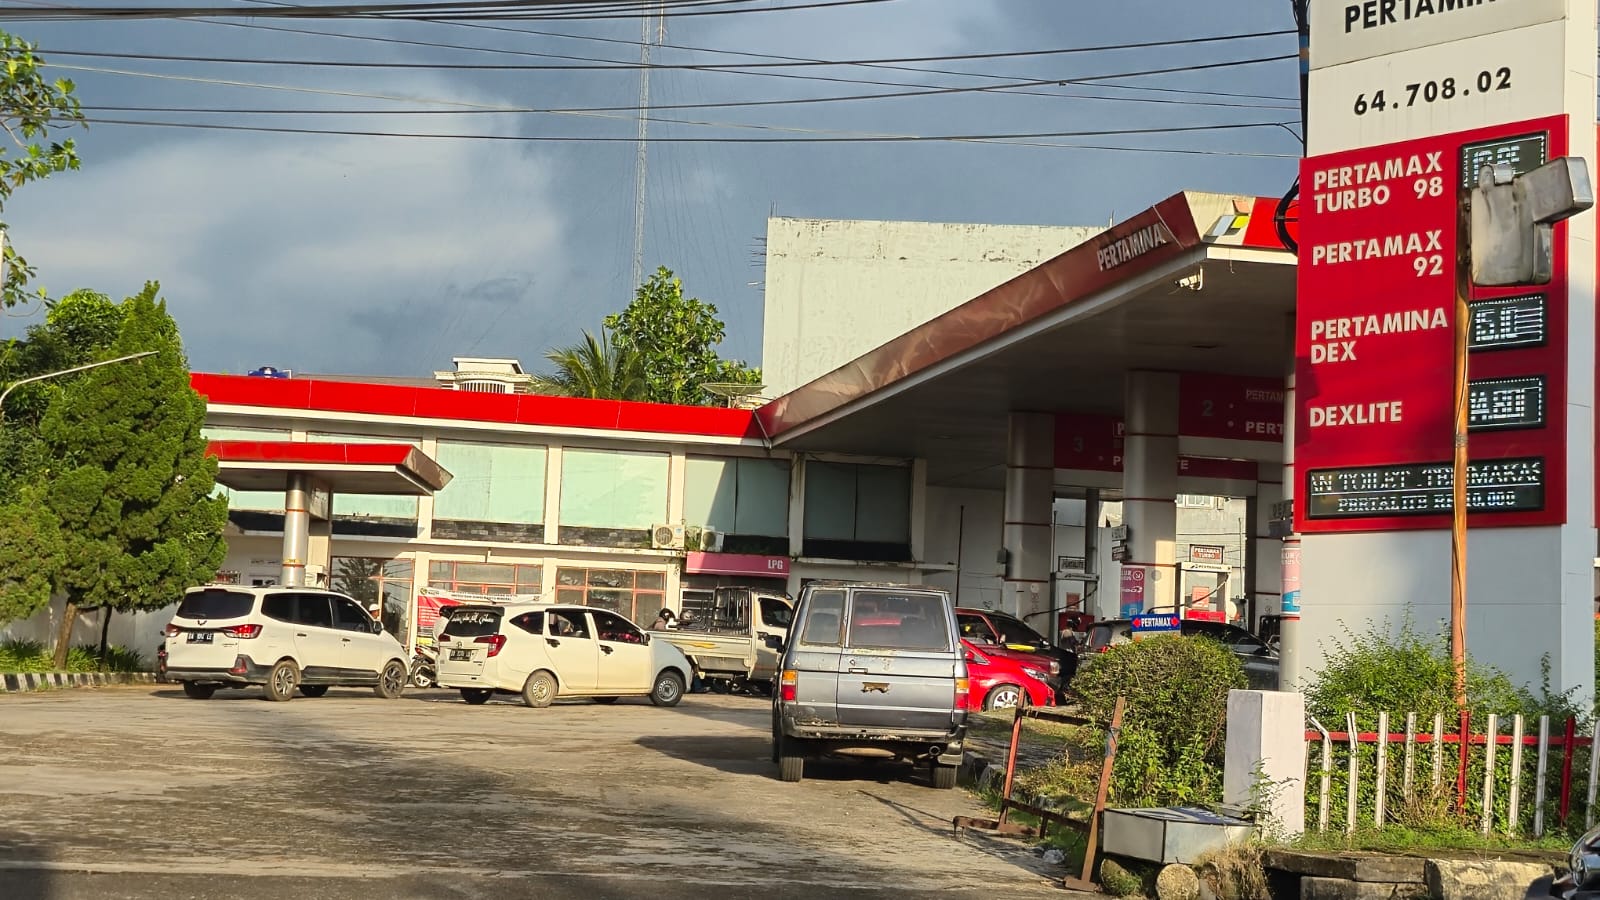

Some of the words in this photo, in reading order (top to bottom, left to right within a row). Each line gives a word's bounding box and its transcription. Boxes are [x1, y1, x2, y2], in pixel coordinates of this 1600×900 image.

[1345, 0, 1497, 33] PERTA
[1353, 66, 1512, 116] 64.708.02
[1313, 151, 1443, 191] PERTAMAX
[1314, 184, 1390, 214] TURBO
[1413, 176, 1443, 200] 98
[1096, 222, 1167, 272] PERTAMINA
[1312, 229, 1443, 266] PERTAMAX
[1413, 255, 1443, 277] 92
[1311, 307, 1448, 341] PERTAMINA
[1310, 340, 1357, 365] DEX
[1309, 401, 1403, 428] DEXLITE
[1337, 494, 1429, 512] PERTALITE
[767, 559, 784, 570] LPG
[1141, 616, 1172, 628] PERTAMAX
